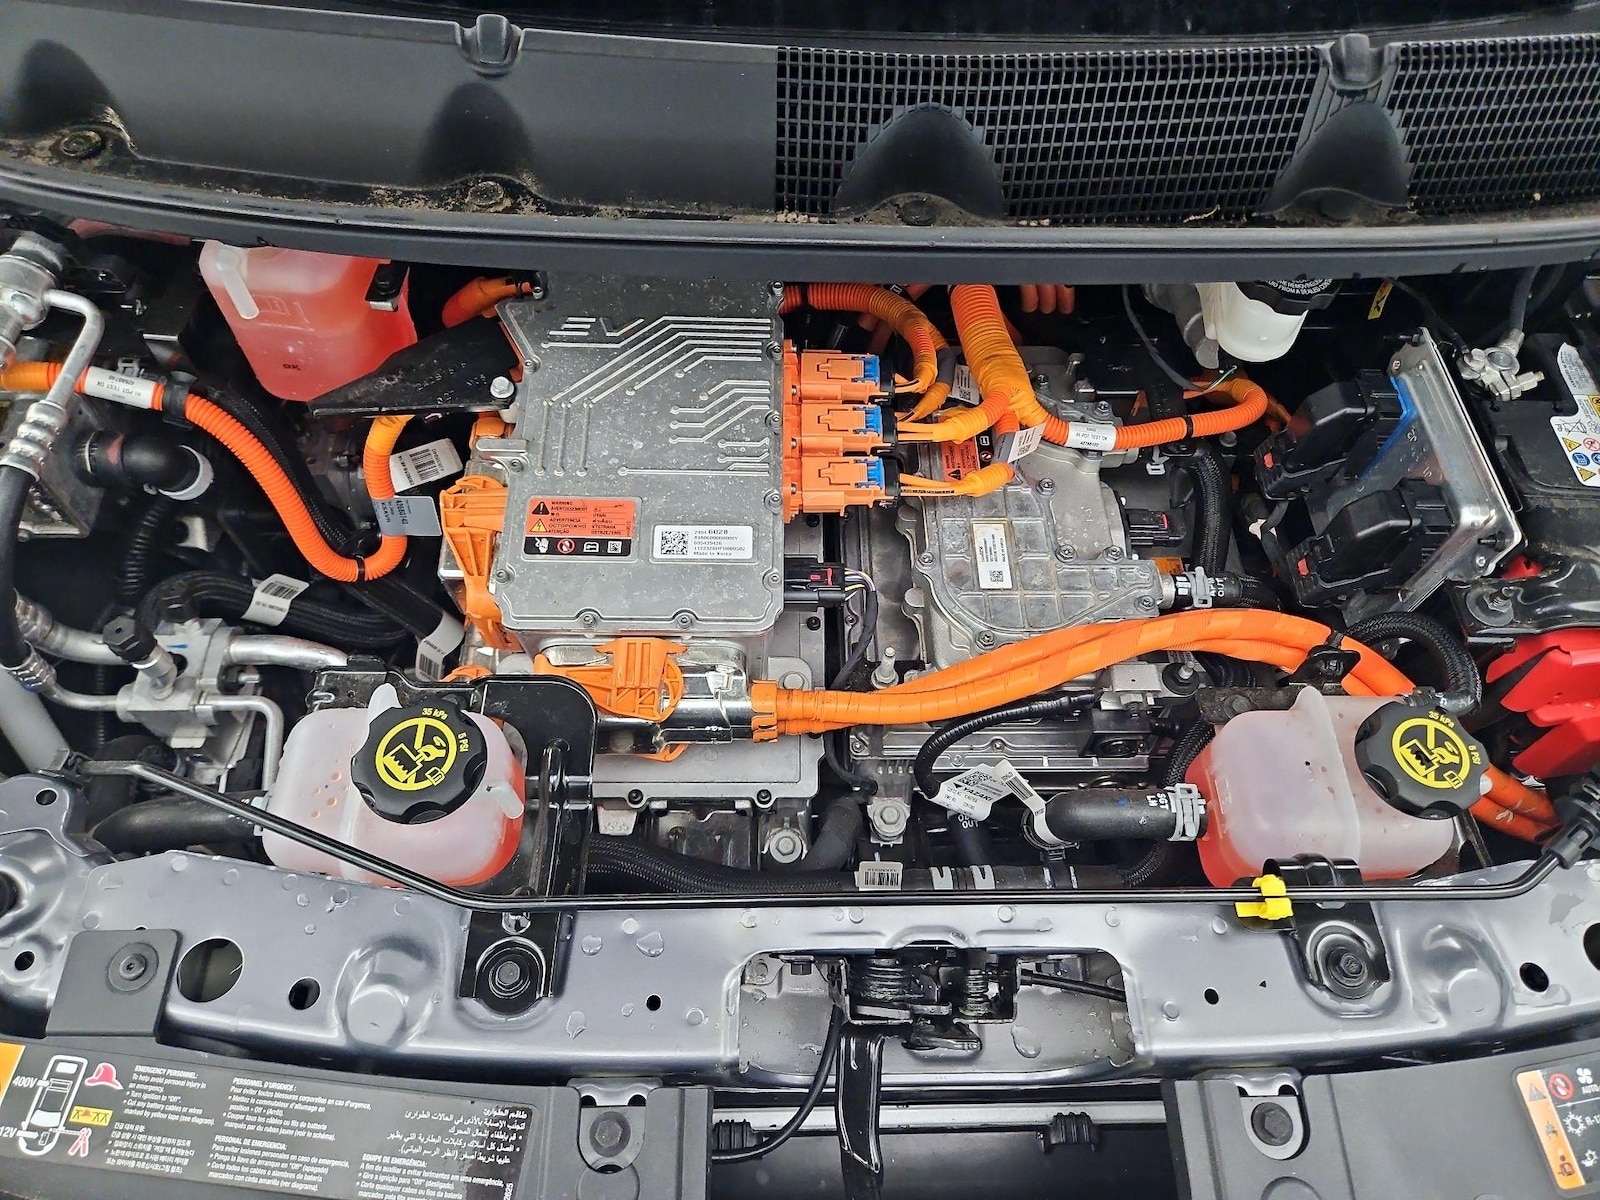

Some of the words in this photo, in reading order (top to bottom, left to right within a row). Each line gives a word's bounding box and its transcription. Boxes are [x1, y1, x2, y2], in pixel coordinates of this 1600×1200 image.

[422, 708, 433, 716] 35
[433, 708, 448, 720] kPa
[1428, 711, 1439, 720] 35
[1440, 714, 1455, 728] kPa
[459, 738, 469, 752] PSI
[1471, 751, 1481, 764] PSI
[135, 1065, 166, 1075] EMERGENCY
[166, 1069, 199, 1079] PERSONNEL:
[12, 1076, 38, 1088] 400V
[139, 1074, 150, 1082] help
[164, 1078, 186, 1086] personal
[186, 1080, 201, 1089] injury
[233, 1077, 263, 1087] PERSONNEL
[232, 1095, 250, 1103] Mettez
[256, 1099, 289, 1108] commutateur
[274, 1092, 298, 1100] blessures
[299, 1096, 327, 1104] corporelles
[146, 1101, 165, 1110] battery
[227, 1112, 245, 1120] Couper
[307, 1122, 327, 1130] batterie
[0, 1126, 17, 1138] 12V
[215, 1134, 242, 1145] PERSONAL
[251, 1139, 287, 1150] EMERGENCIA:
[240, 1147, 261, 1156] lesiones
[261, 1150, 290, 1160] personales
[362, 1153, 382, 1162] EQUIPE
[211, 1161, 225, 1169] Corte
[271, 1170, 296, 1179] alambres
[214, 1153, 230, 1162] Ponga
[257, 1159, 280, 1168] arranque
[303, 1164, 329, 1175] (apagado)
[208, 1171, 234, 1180] marcados
[422, 1170, 450, 1180] ferimentos
